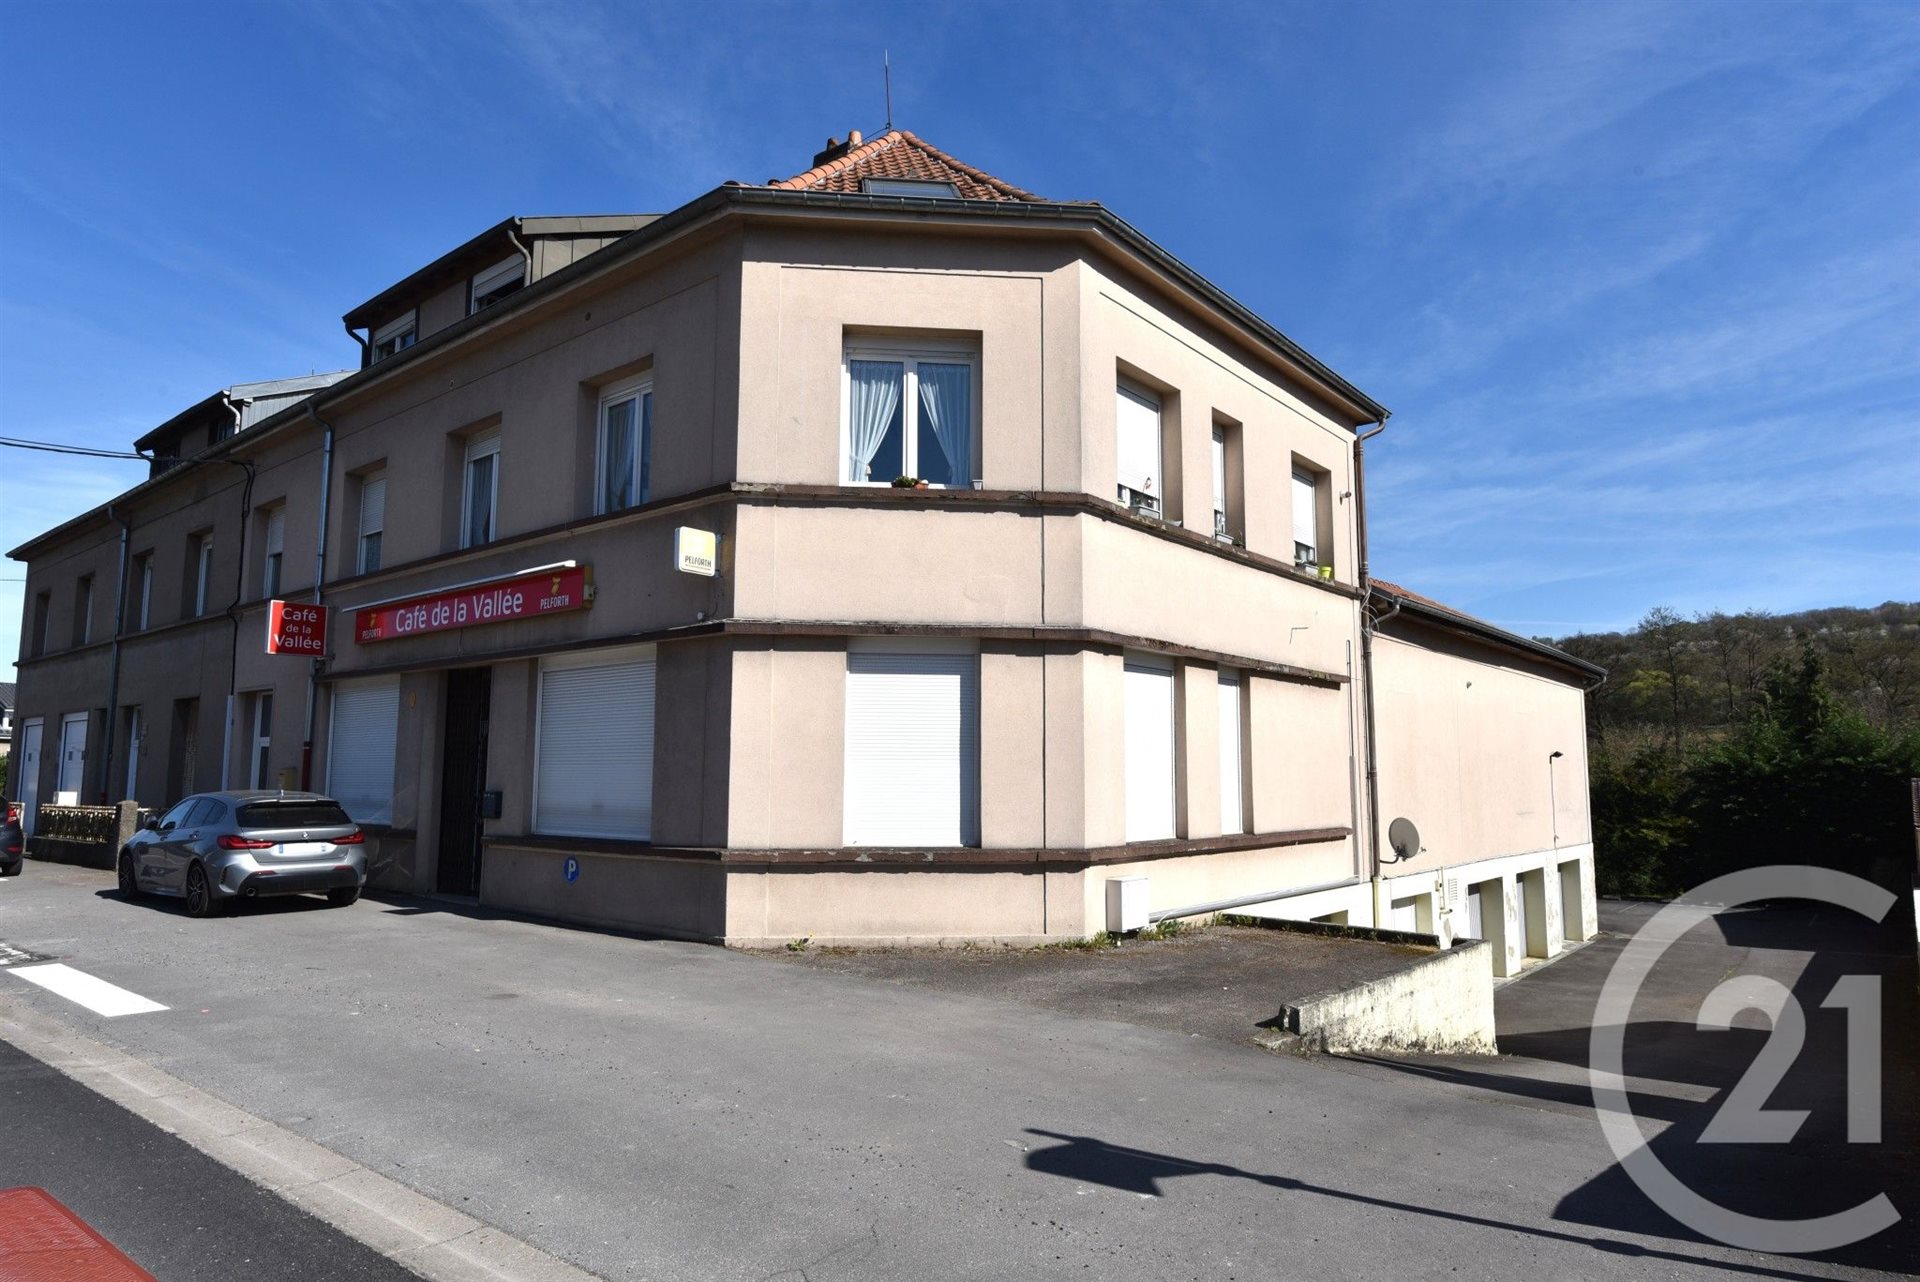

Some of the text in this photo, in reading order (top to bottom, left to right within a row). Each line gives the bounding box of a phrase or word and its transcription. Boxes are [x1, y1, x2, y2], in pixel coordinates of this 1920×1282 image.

[684, 555, 712, 567] PELFORTH
[540, 594, 569, 610] PELFORTH
[282, 608, 317, 622] Café
[396, 589, 523, 632] Café de la Vallée
[286, 624, 312, 633] de la
[274, 634, 321, 649] Vallée
[567, 859, 577, 879] P
